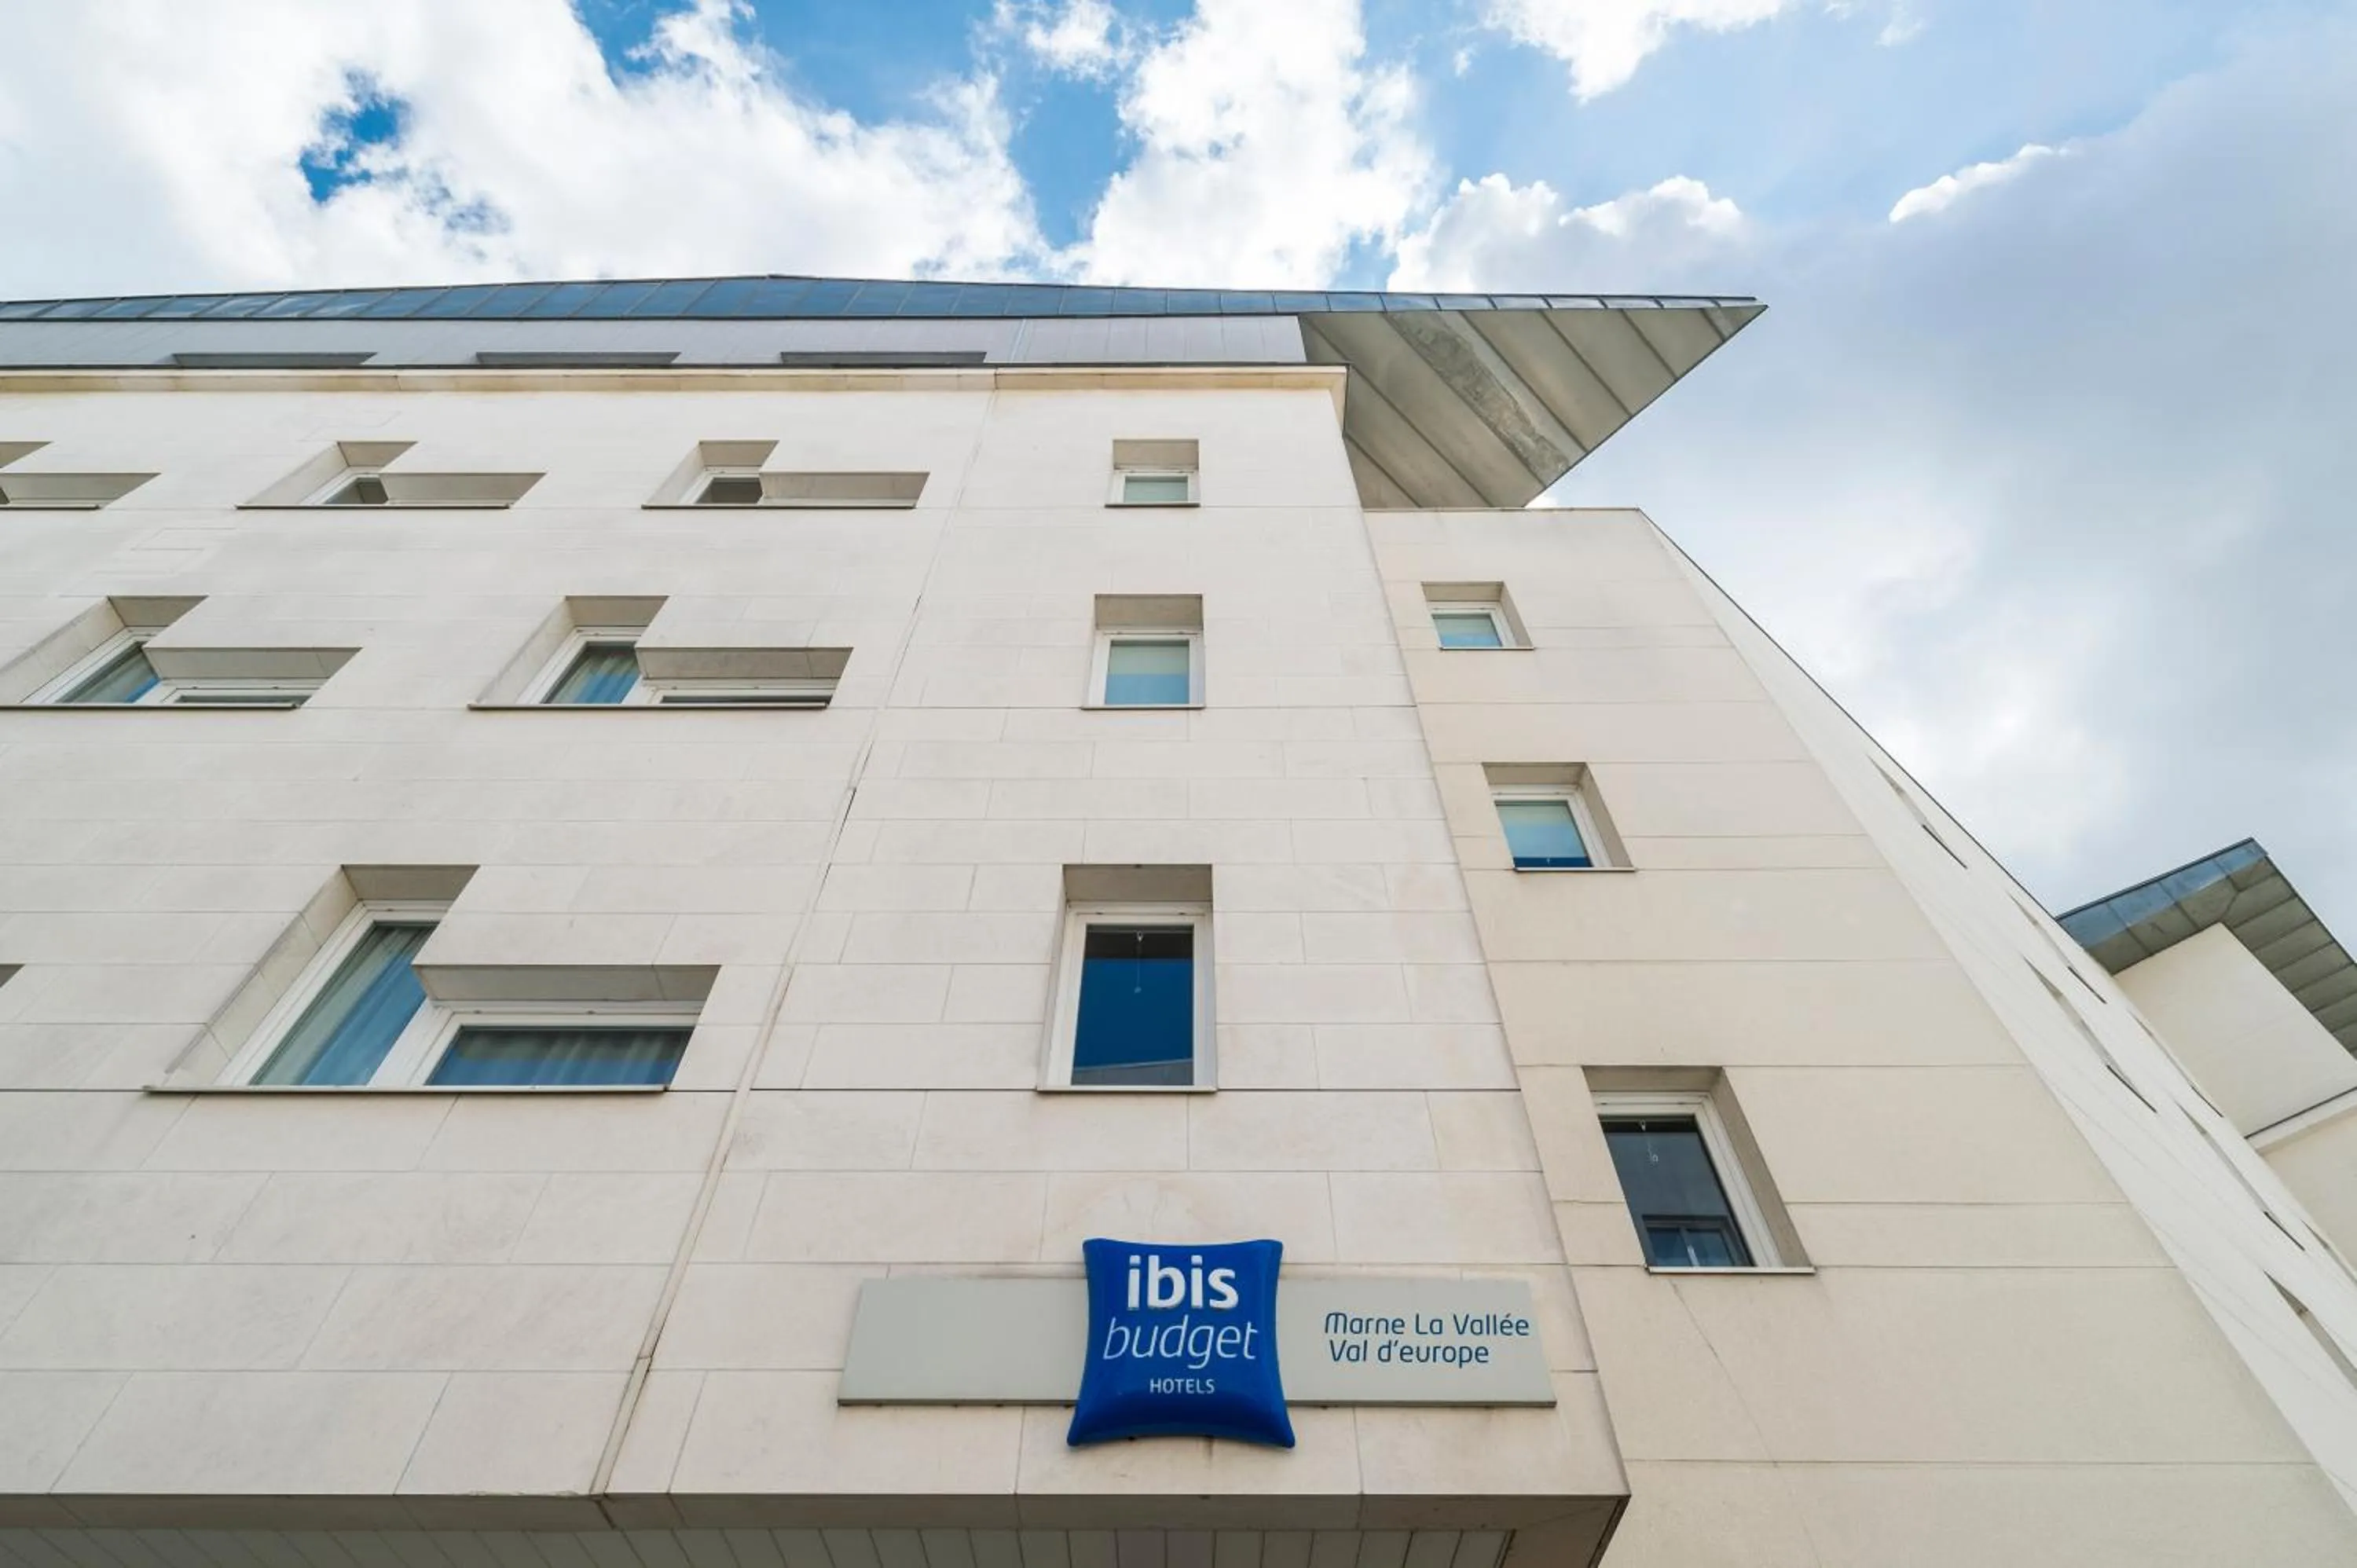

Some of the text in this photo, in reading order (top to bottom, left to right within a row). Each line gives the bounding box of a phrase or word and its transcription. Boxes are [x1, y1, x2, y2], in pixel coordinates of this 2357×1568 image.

[1127, 1254, 1239, 1310] ibis
[1324, 1311, 1530, 1336] Marne La Vallée
[1102, 1314, 1259, 1369] budget
[1329, 1338, 1490, 1369] Val d'europe
[1149, 1378, 1215, 1393] HOTELS
